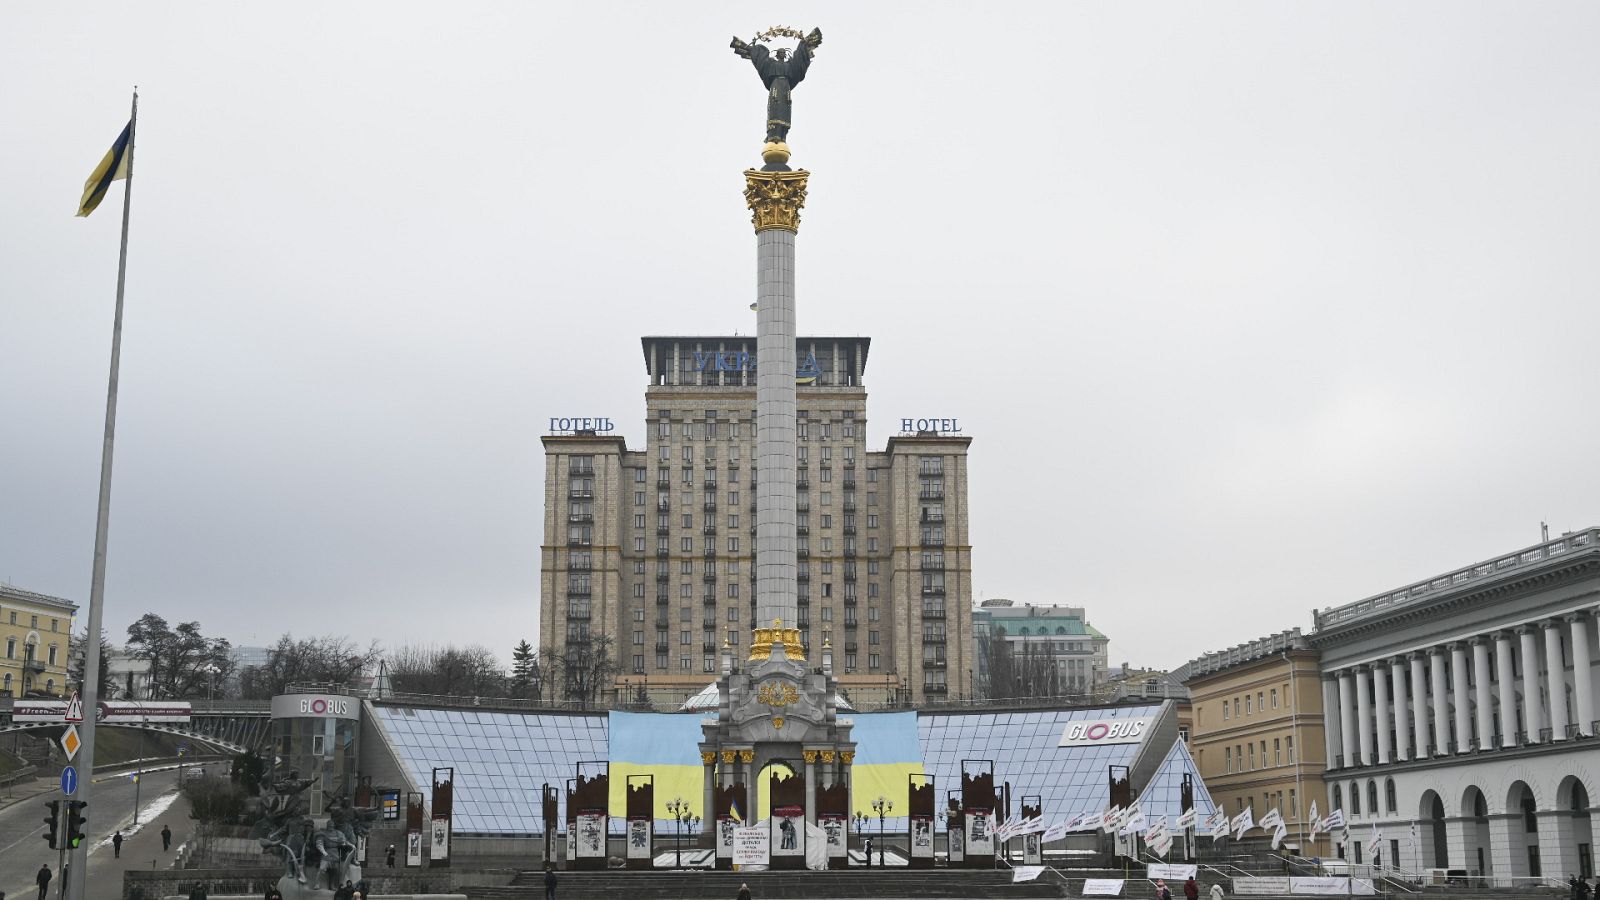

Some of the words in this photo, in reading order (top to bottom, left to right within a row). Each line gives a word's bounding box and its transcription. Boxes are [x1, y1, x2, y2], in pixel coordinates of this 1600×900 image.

[549, 417, 614, 431] ГОТЕЛЬ
[900, 418, 962, 432] HOTEL
[301, 699, 347, 714] GLOBUS
[1068, 720, 1144, 740] GLOBUS
